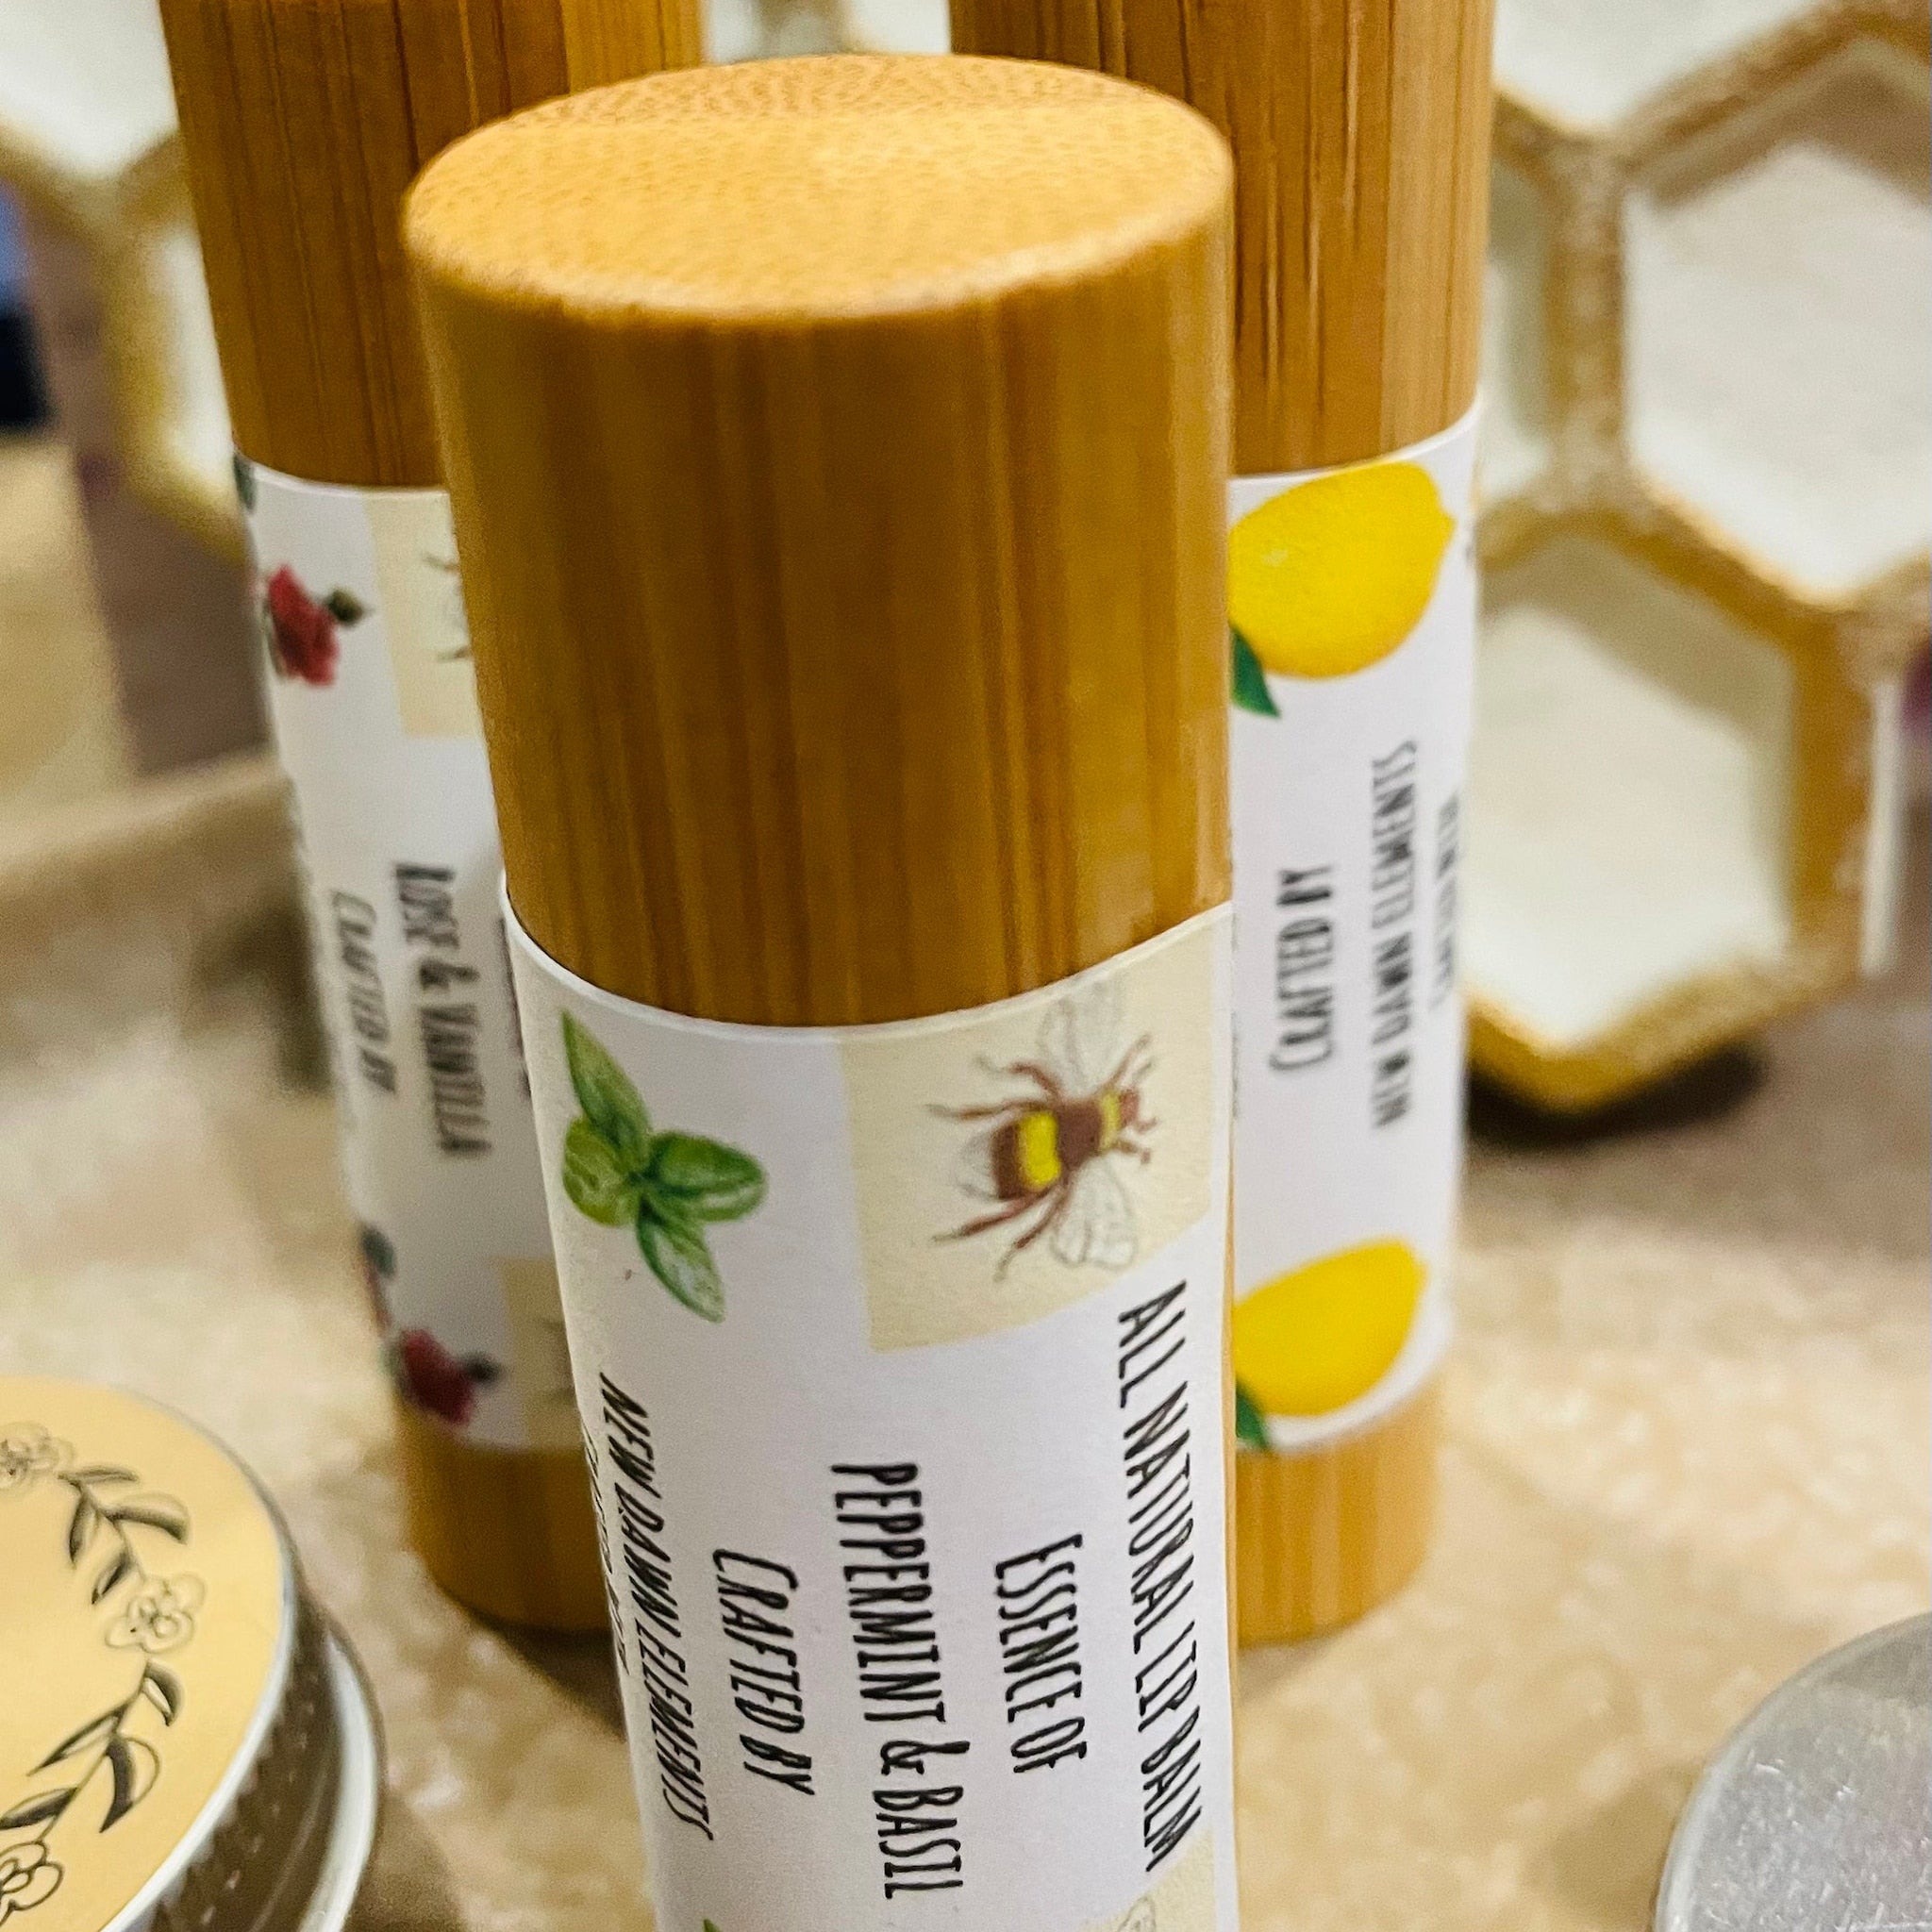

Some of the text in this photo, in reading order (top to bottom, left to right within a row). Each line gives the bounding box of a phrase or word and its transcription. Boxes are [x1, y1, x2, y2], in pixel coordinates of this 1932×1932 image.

[1276, 865, 1333, 906] BY
[599, 1371, 663, 1499] NEW
[614, 1481, 682, 1639] DAWN
[711, 1548, 816, 1796] CRAFTED BY
[994, 1532, 1088, 1774] ESSENCE OF
[1119, 1279, 1203, 1873] ALL NATURAL LIP BALM
[634, 1616, 714, 1841] ELEMENTS
[831, 1462, 971, 1900] PEPPERMINT & BASIL
